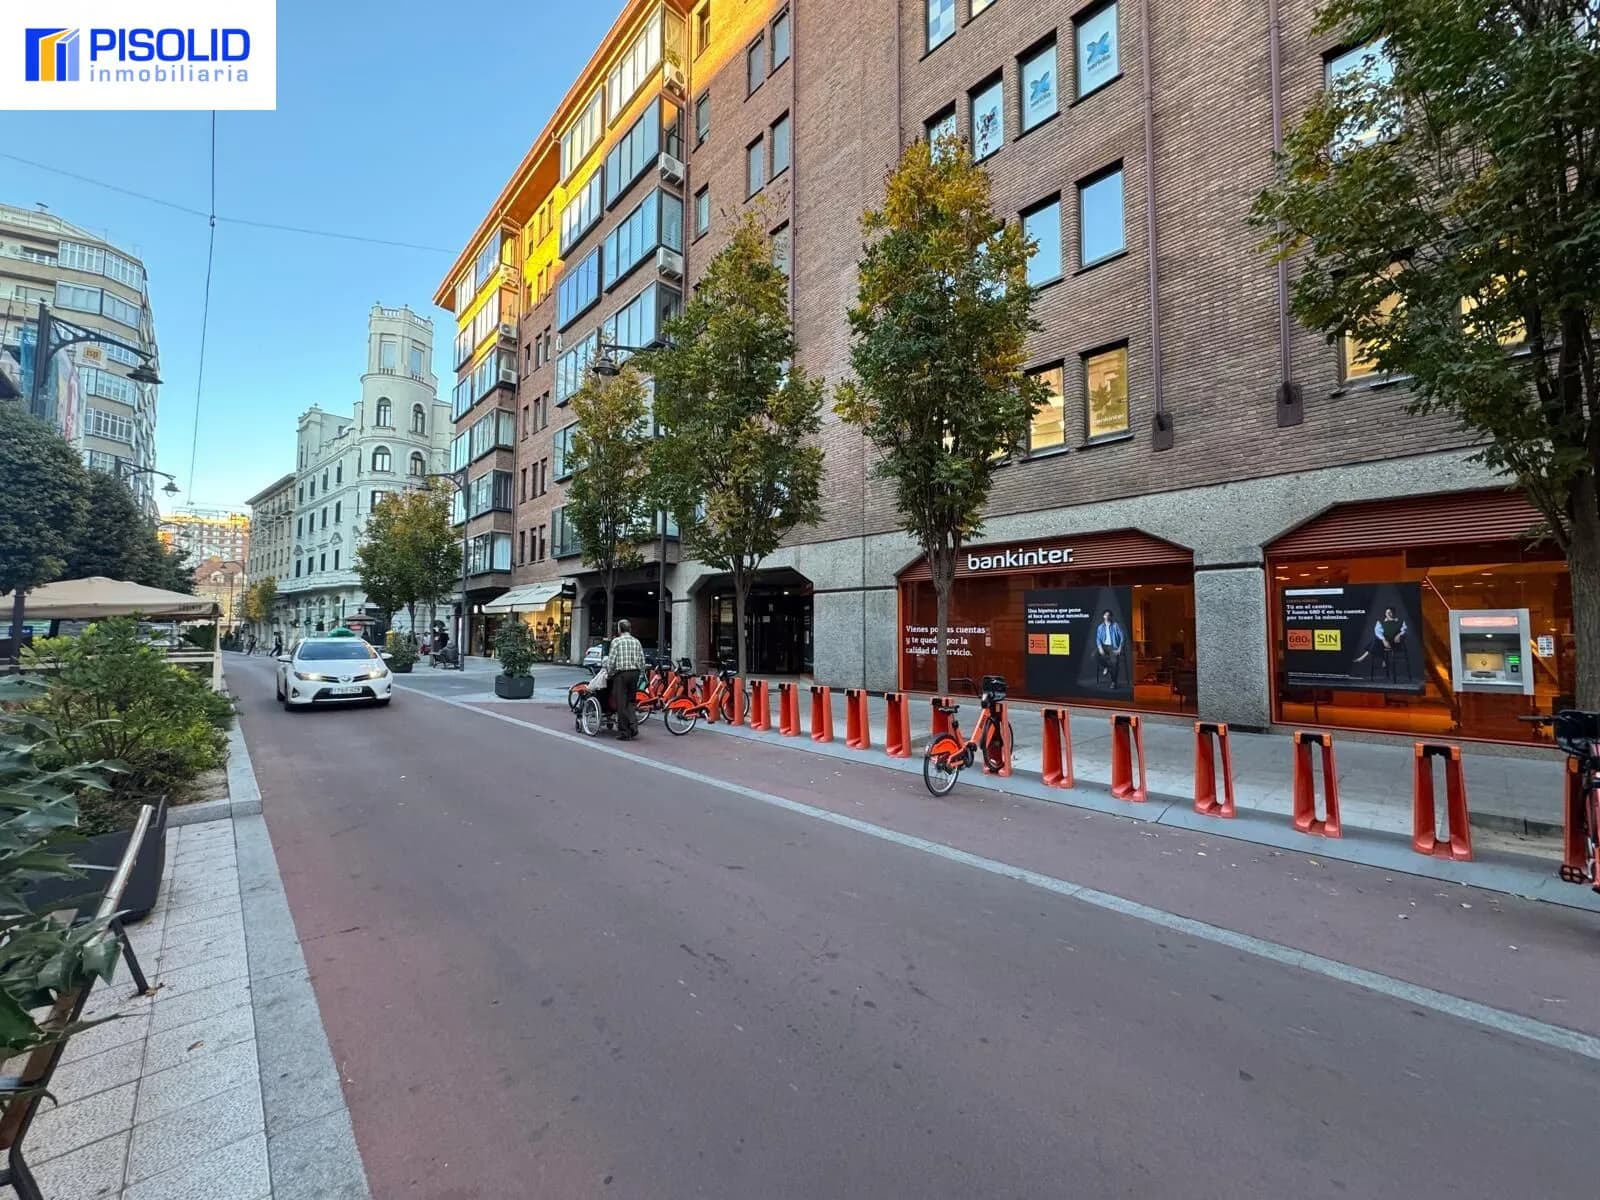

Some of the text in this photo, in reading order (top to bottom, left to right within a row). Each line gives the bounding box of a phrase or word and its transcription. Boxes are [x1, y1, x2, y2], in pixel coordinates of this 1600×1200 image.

[905, 625, 928, 633] Vienes
[955, 626, 986, 634] cuentas
[905, 637, 910, 645] y
[946, 638, 959, 646] por
[960, 636, 968, 645] la
[1317, 633, 1338, 643] SIN
[905, 646, 930, 655] calidad
